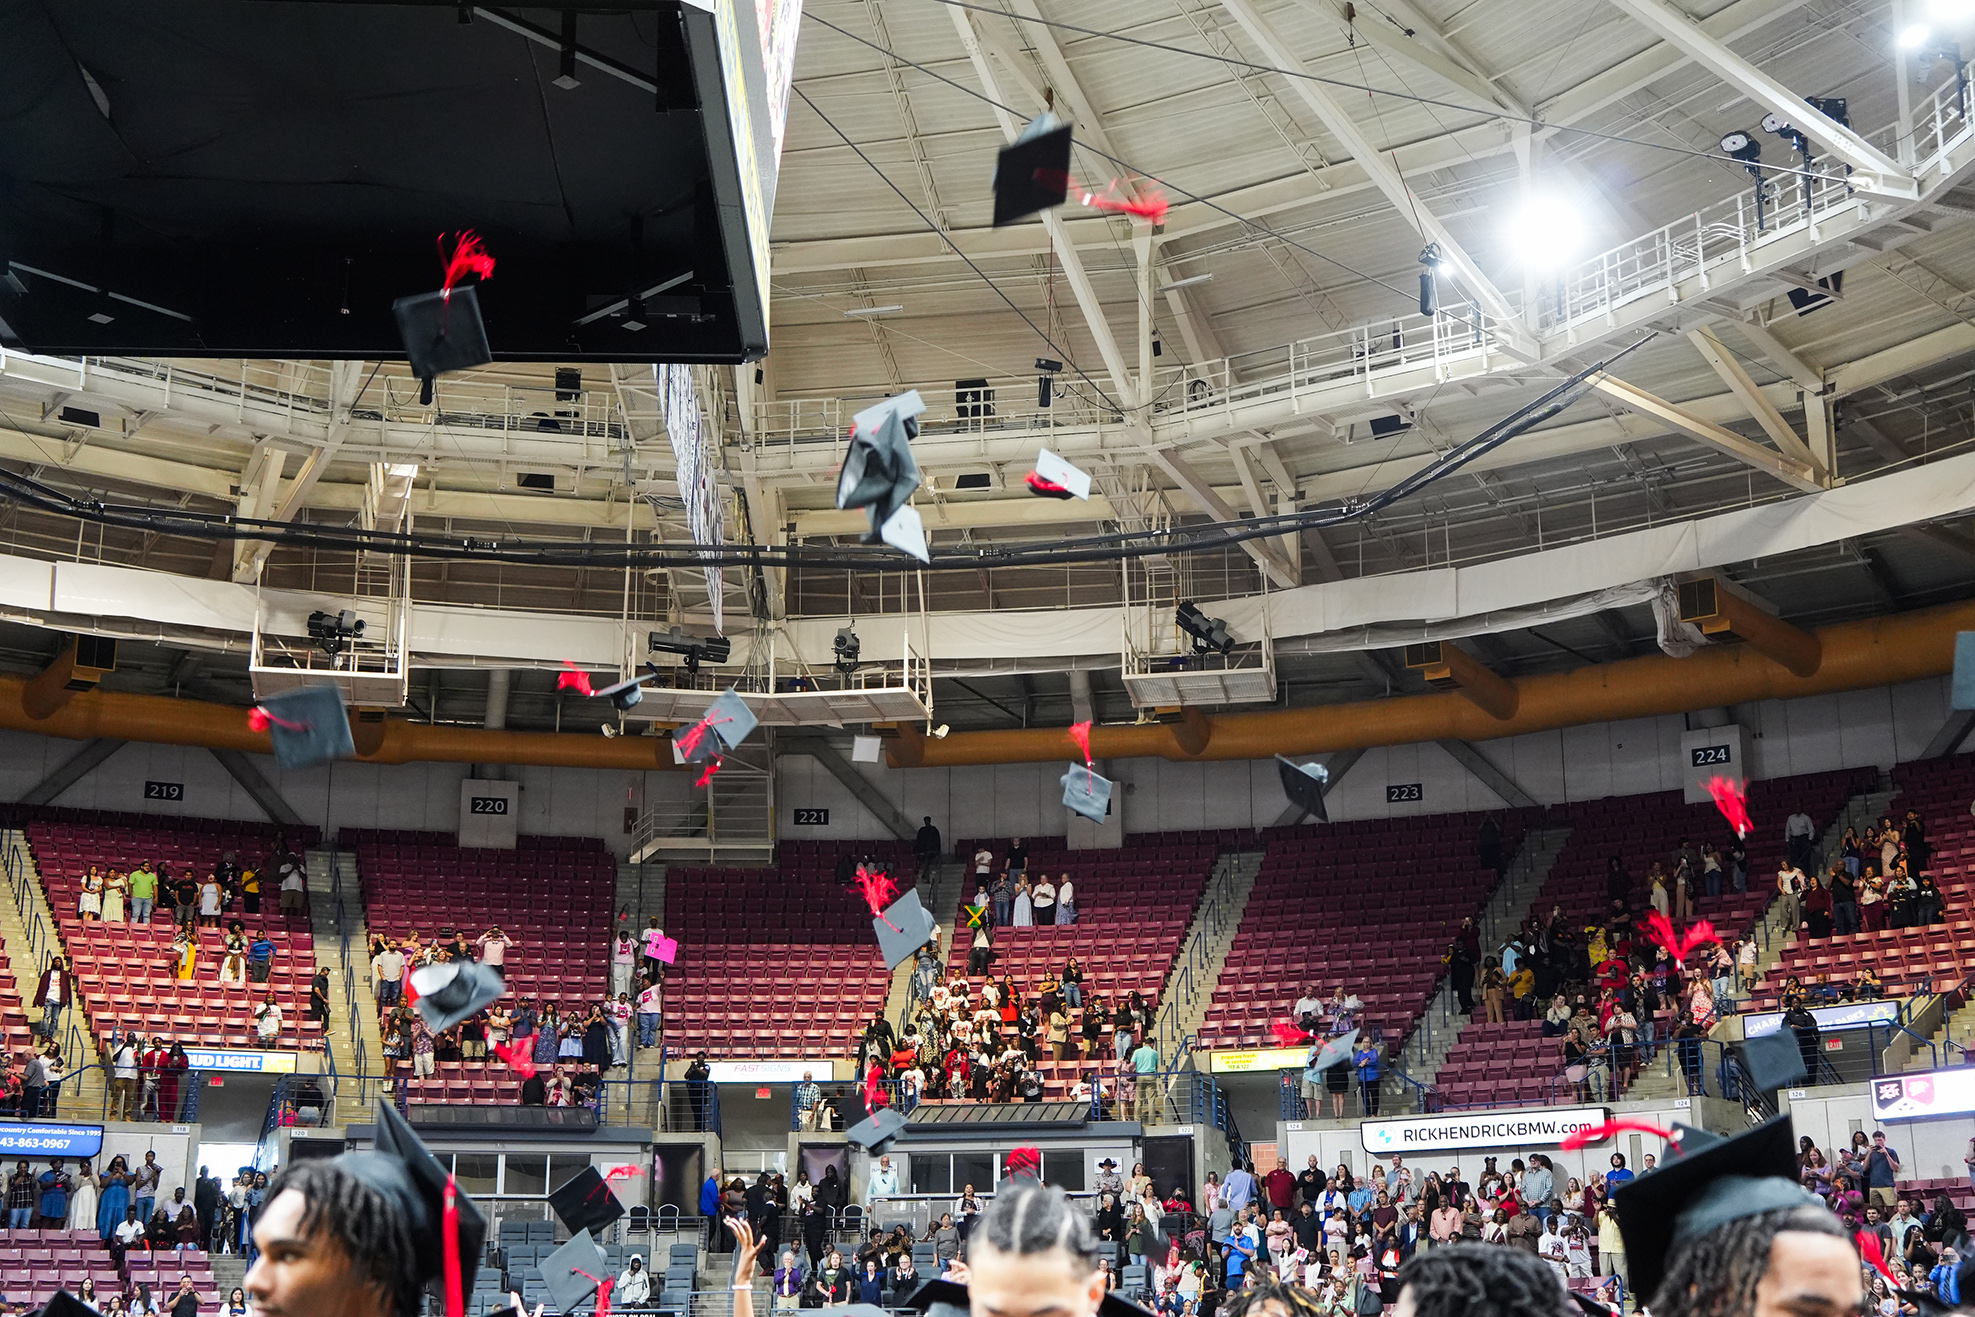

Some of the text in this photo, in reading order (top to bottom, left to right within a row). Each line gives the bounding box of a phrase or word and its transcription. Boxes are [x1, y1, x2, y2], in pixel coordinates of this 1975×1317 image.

[1696, 748, 1726, 764] 224
[150, 784, 179, 798] 219
[1391, 786, 1419, 800] 223
[475, 800, 504, 813] 220
[800, 811, 824, 823] 221
[1834, 1009, 1866, 1025] PARKS
[1828, 1038, 1840, 1049] EXIT
[734, 1064, 791, 1072] FASTSIGNS
[27, 1127, 67, 1136] Comfortable
[1404, 1121, 1592, 1142] RICKHENDRICKBMW.com
